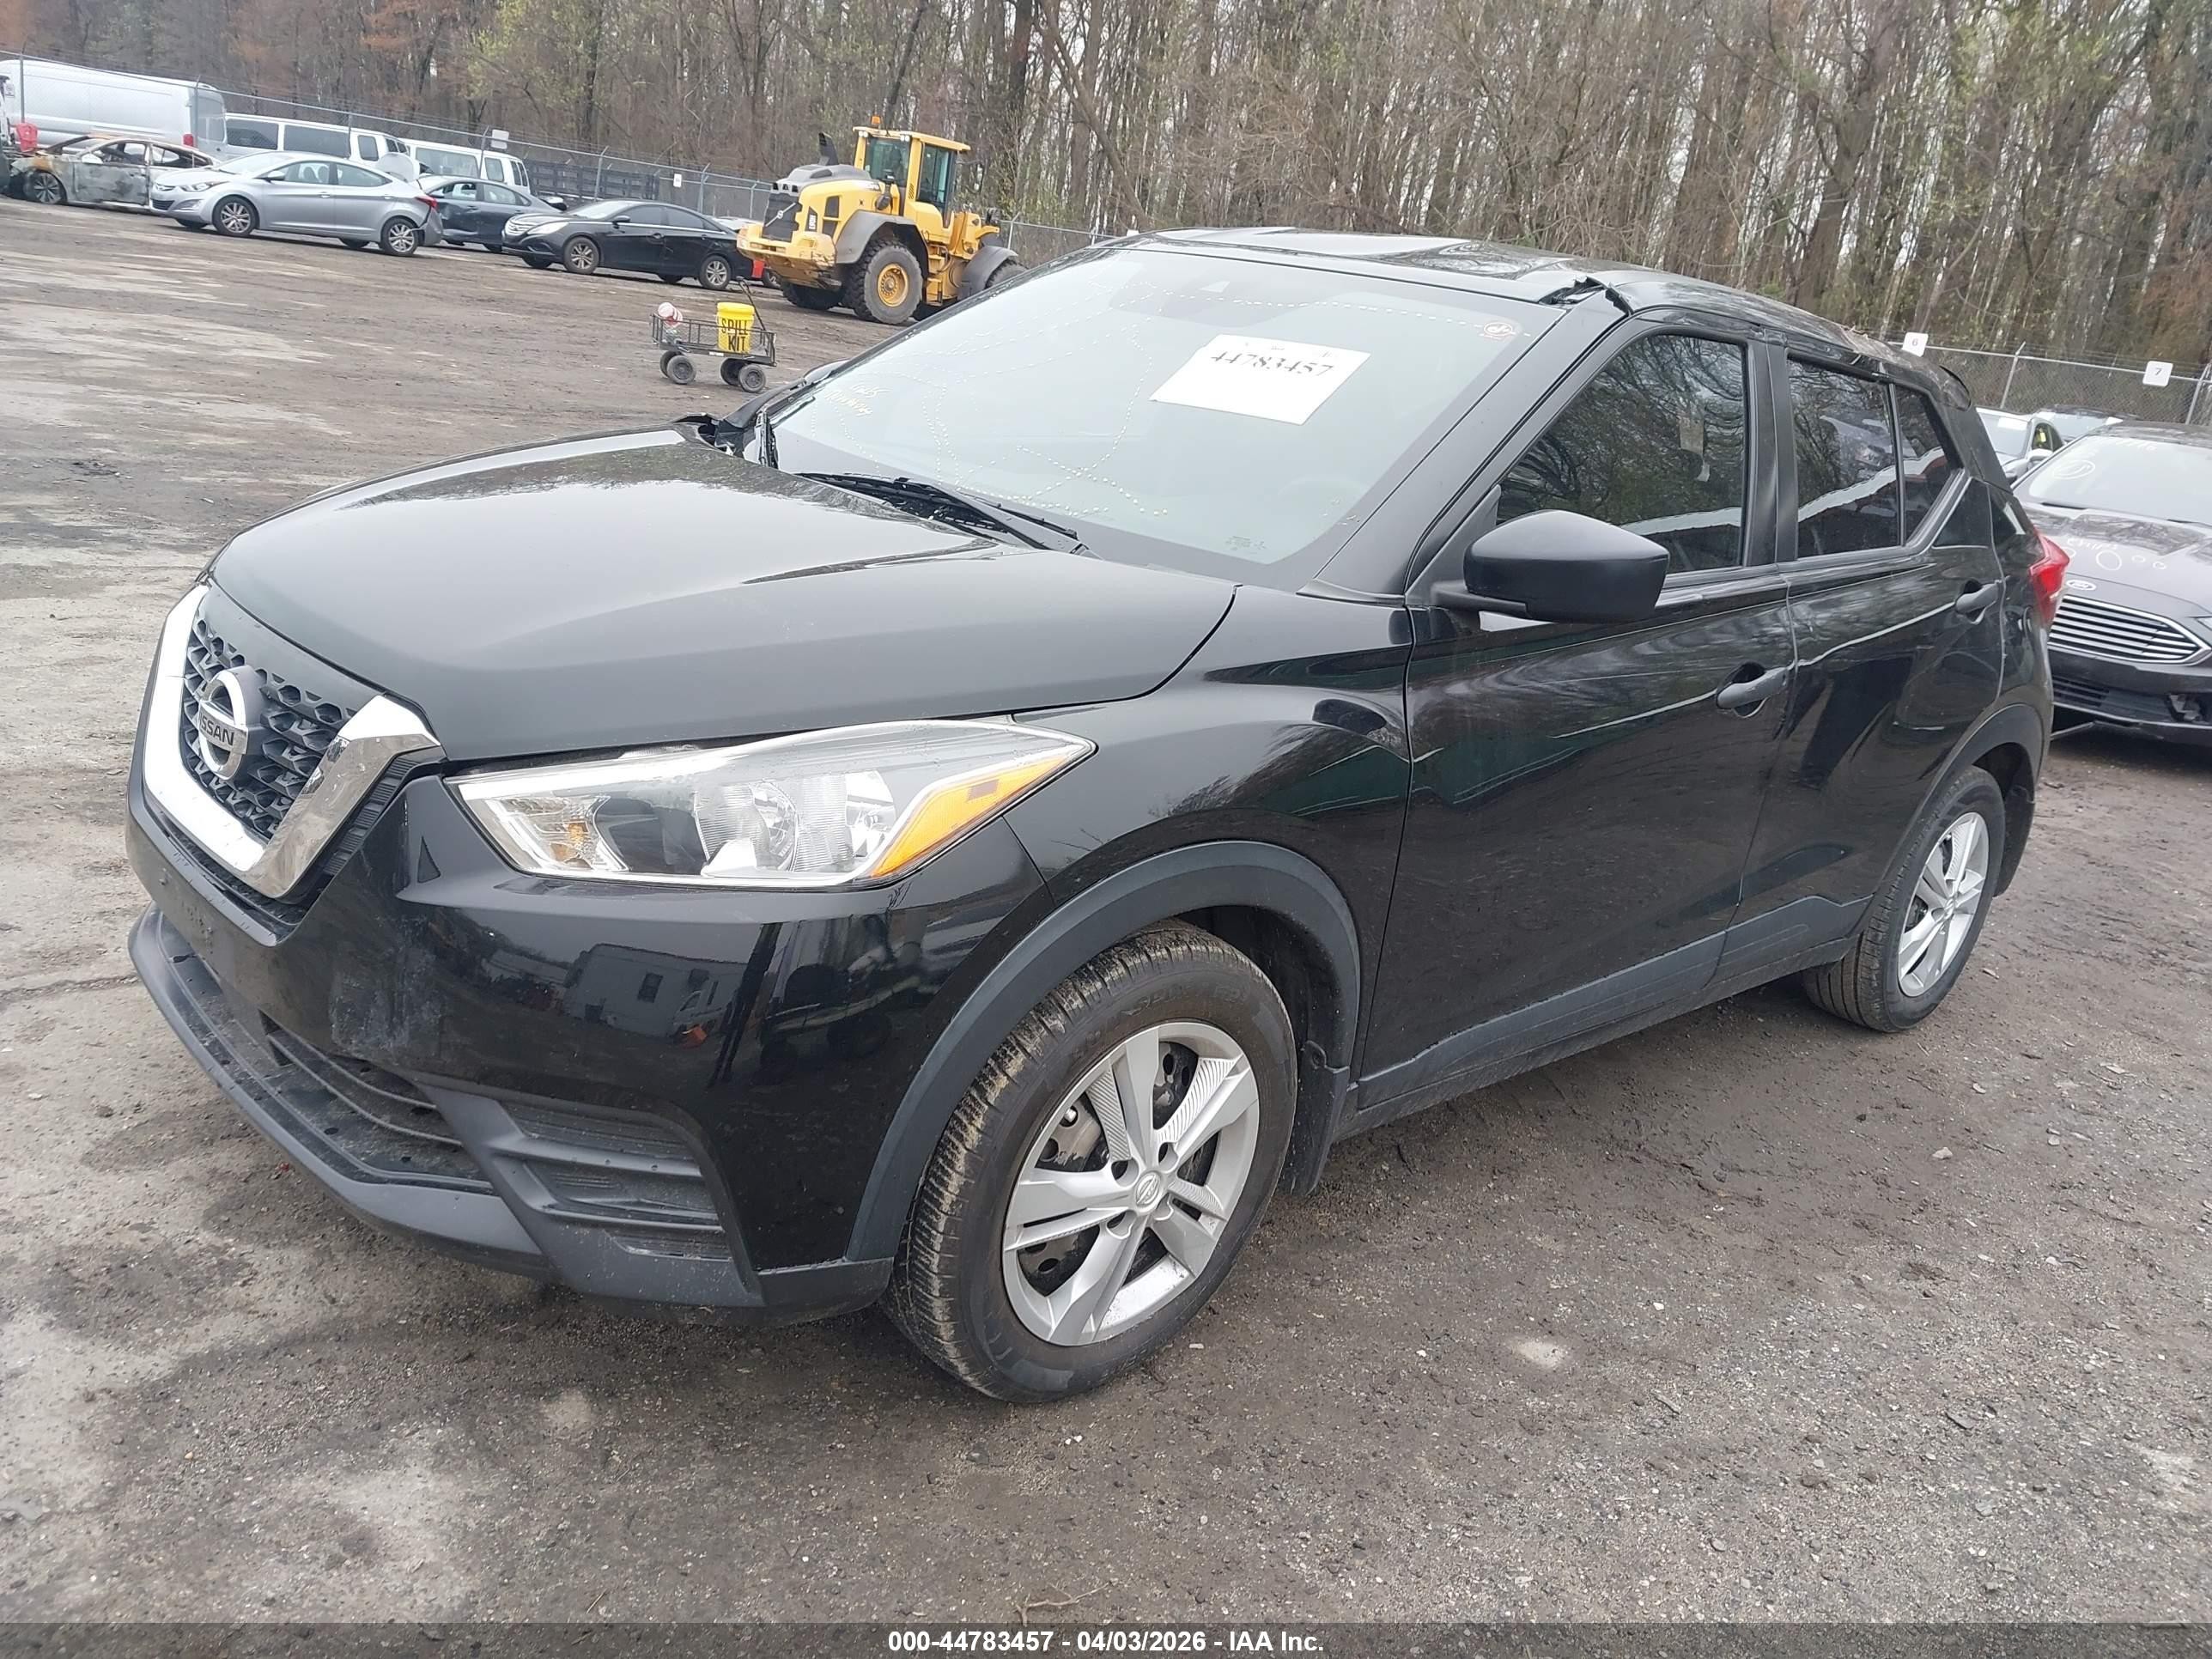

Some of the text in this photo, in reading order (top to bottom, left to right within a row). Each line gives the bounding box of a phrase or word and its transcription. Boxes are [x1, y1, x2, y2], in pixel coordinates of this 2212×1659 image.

[721, 318, 748, 336] SPILL
[728, 335, 746, 352] KIT
[1911, 337, 1918, 347] 6
[2154, 367, 2162, 376] 7
[198, 712, 235, 746] ISSAN
